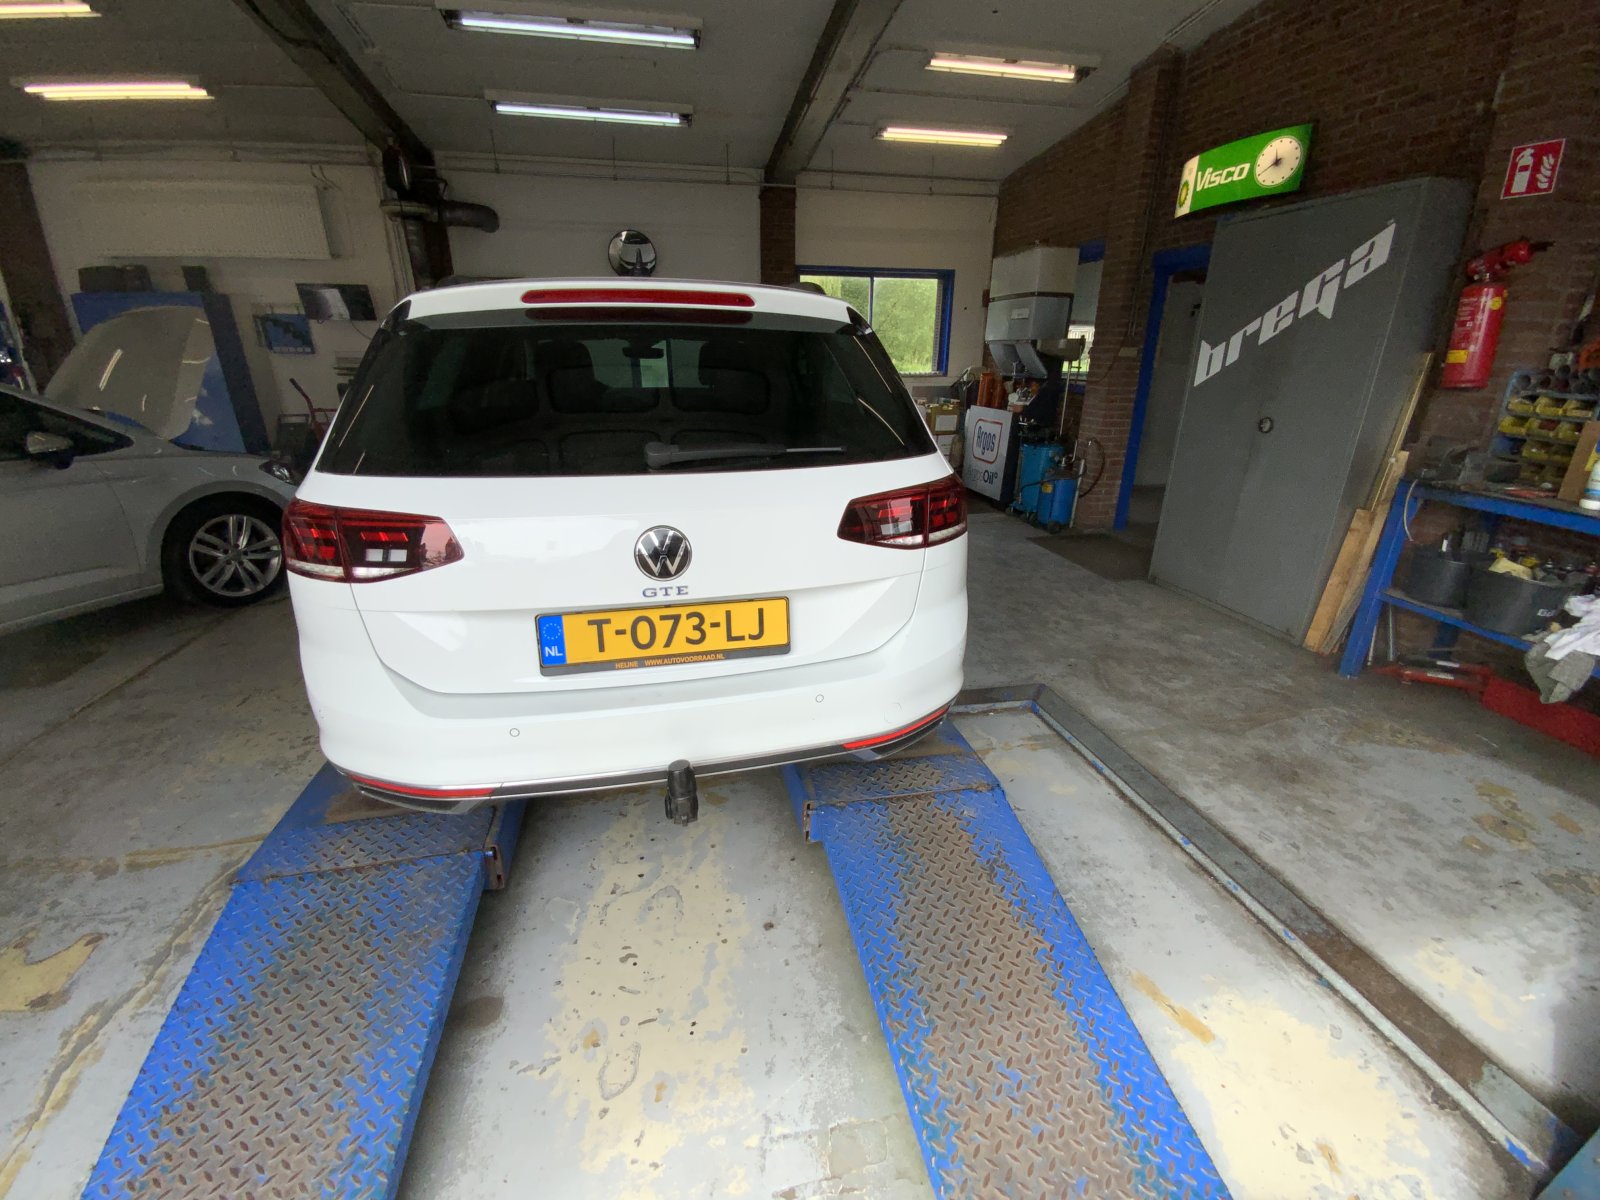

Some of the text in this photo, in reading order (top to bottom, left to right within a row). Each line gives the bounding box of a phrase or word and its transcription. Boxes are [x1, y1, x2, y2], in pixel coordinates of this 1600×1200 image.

[976, 425, 996, 455] Argos
[642, 585, 688, 598] GTE
[587, 607, 765, 653] T-073-LJ
[544, 646, 563, 657] NL
[644, 653, 725, 666] WWW.AUTOVOORRAAD.NL
